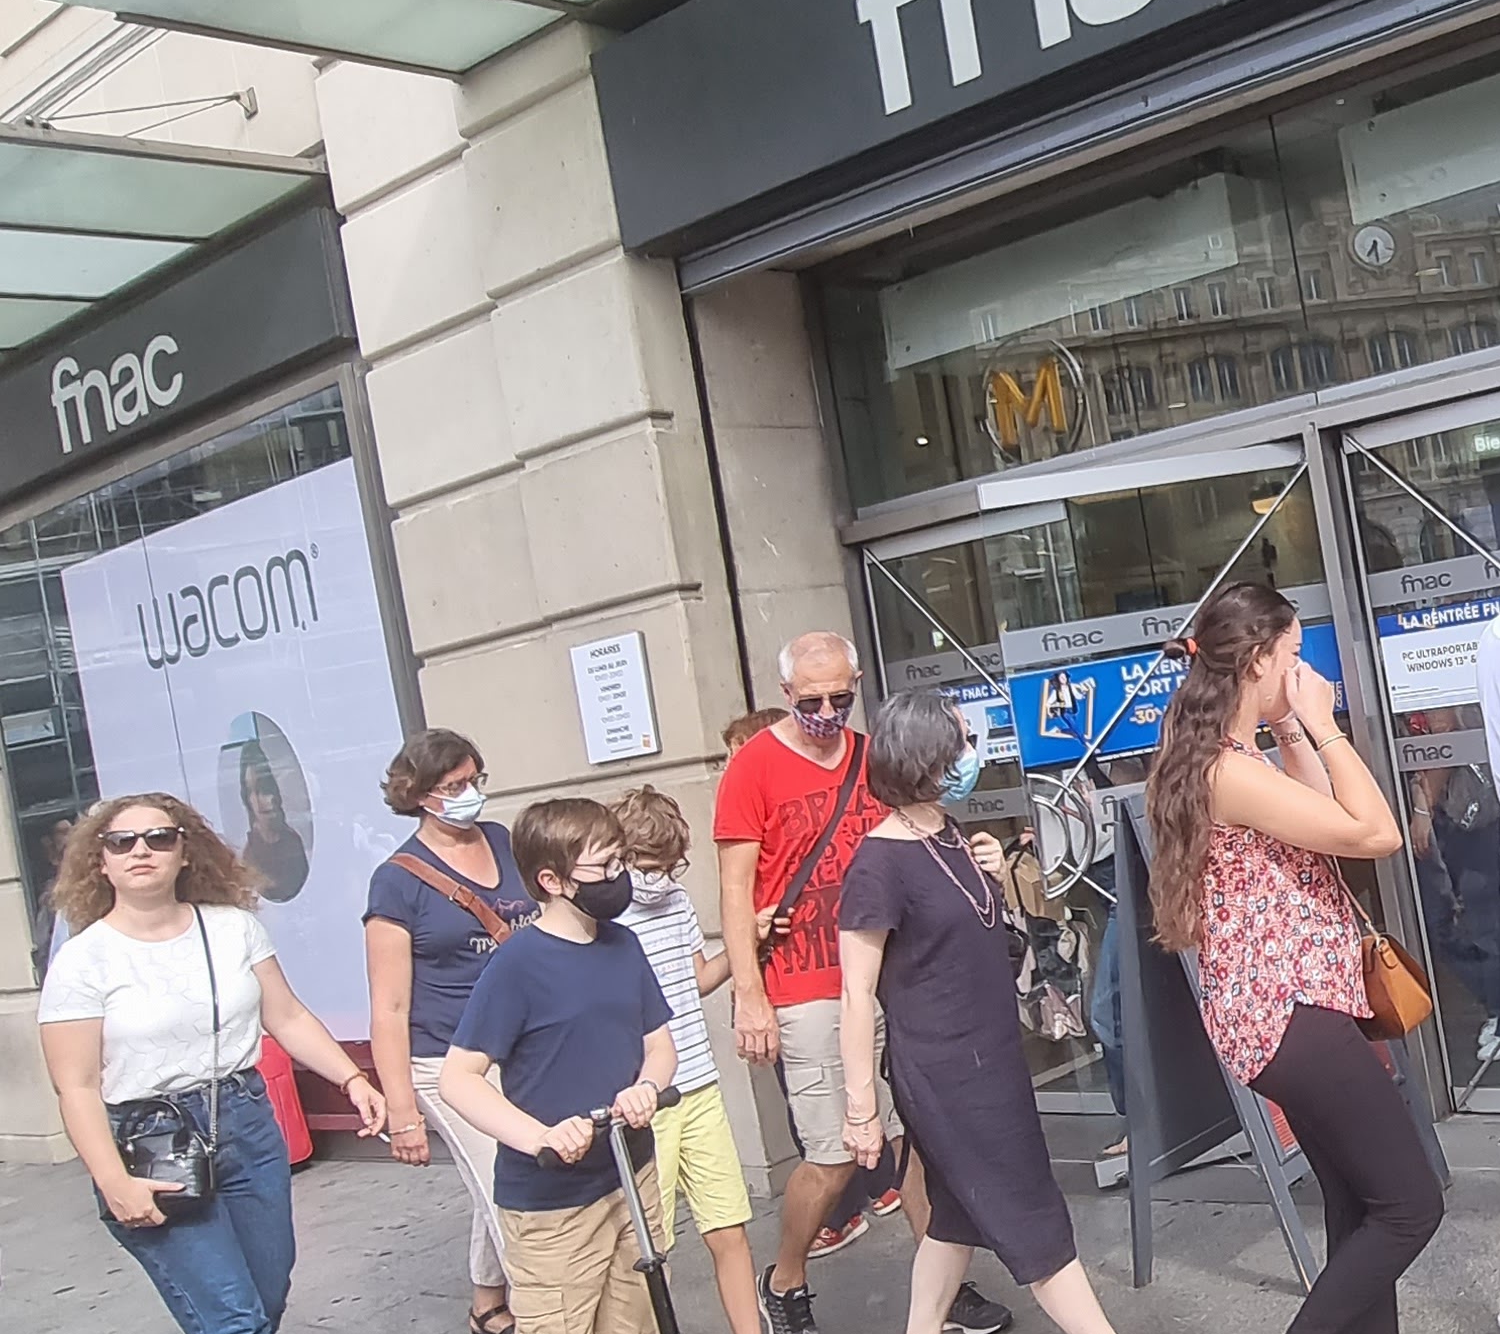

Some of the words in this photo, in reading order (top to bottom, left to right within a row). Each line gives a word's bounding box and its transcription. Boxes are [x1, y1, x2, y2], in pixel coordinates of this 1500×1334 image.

[51, 334, 184, 454] fnac
[990, 357, 1067, 448] M
[1400, 573, 1452, 594] fnac
[136, 548, 318, 670] wacom
[1403, 615, 1420, 630] LA
[1042, 630, 1105, 652] fnac
[1402, 651, 1415, 661] PC
[1407, 658, 1454, 672] WINDOWS
[905, 664, 942, 680] fnac
[1121, 663, 1145, 681] LA
[1402, 744, 1453, 763] fnac
[968, 798, 1004, 814] fnac
